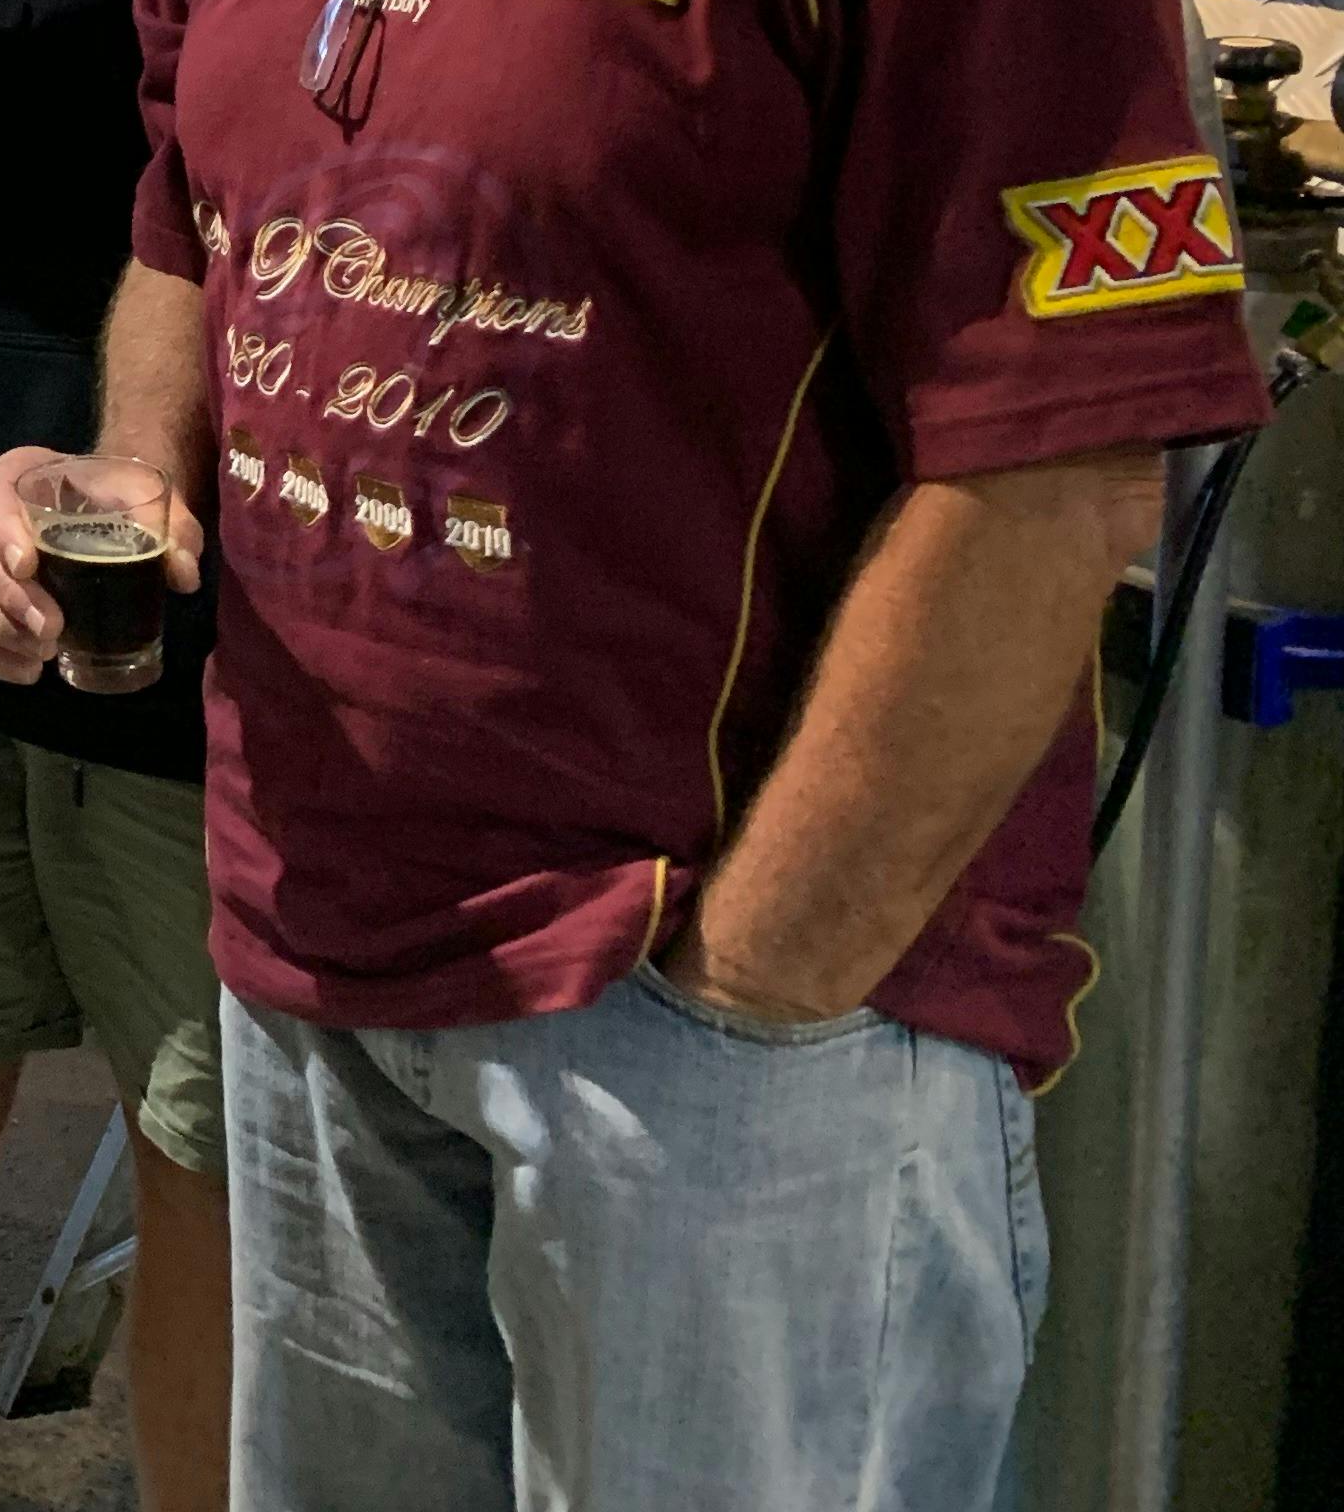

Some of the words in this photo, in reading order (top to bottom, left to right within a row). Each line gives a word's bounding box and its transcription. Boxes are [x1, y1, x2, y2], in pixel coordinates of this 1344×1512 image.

[314, 217, 594, 347] Champions
[324, 361, 509, 448] 2010
[354, 494, 413, 537] 2009
[444, 516, 512, 559] 2010
